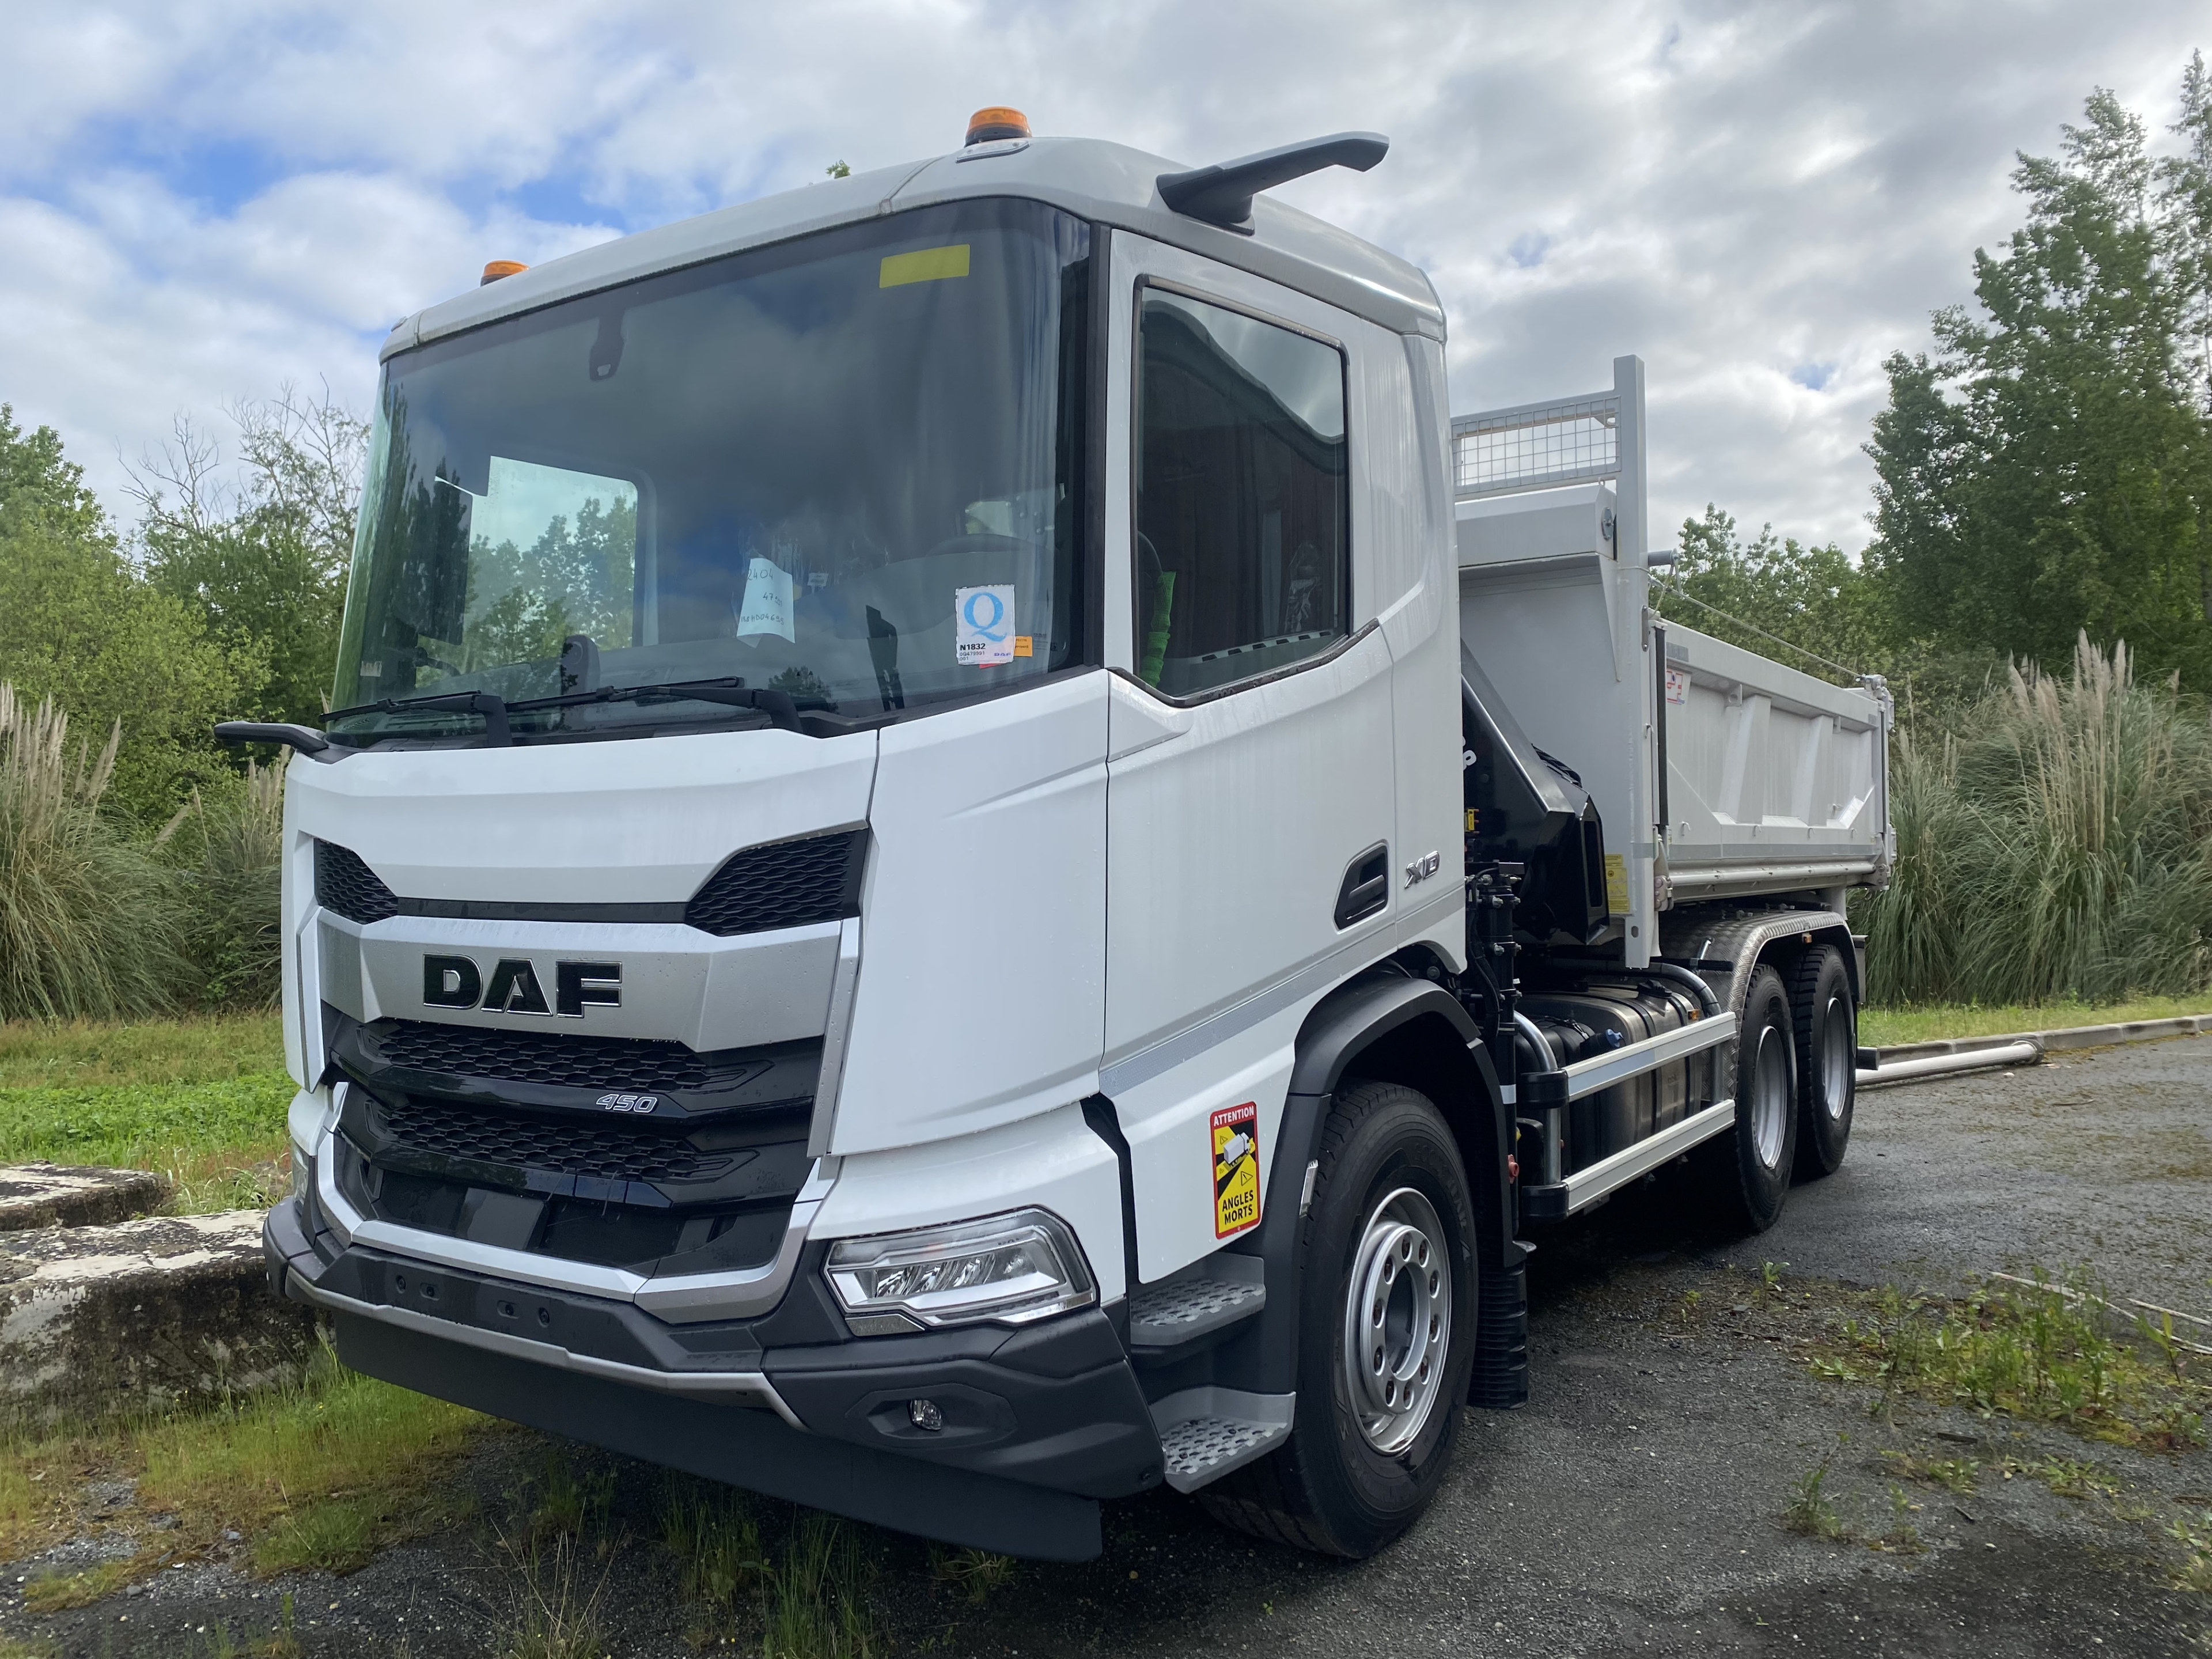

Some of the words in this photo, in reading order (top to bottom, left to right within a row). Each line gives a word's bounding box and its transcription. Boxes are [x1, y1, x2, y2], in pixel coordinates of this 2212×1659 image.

[747, 568, 773, 580] 2404
[964, 592, 1007, 642] Q
[1404, 850, 1440, 889] XD
[423, 953, 623, 1018] DAF
[596, 1094, 657, 1113] 450
[1213, 1105, 1255, 1127] ATTENTION
[1222, 1190, 1253, 1212] ANGLES
[1224, 1204, 1253, 1225] MORTS
